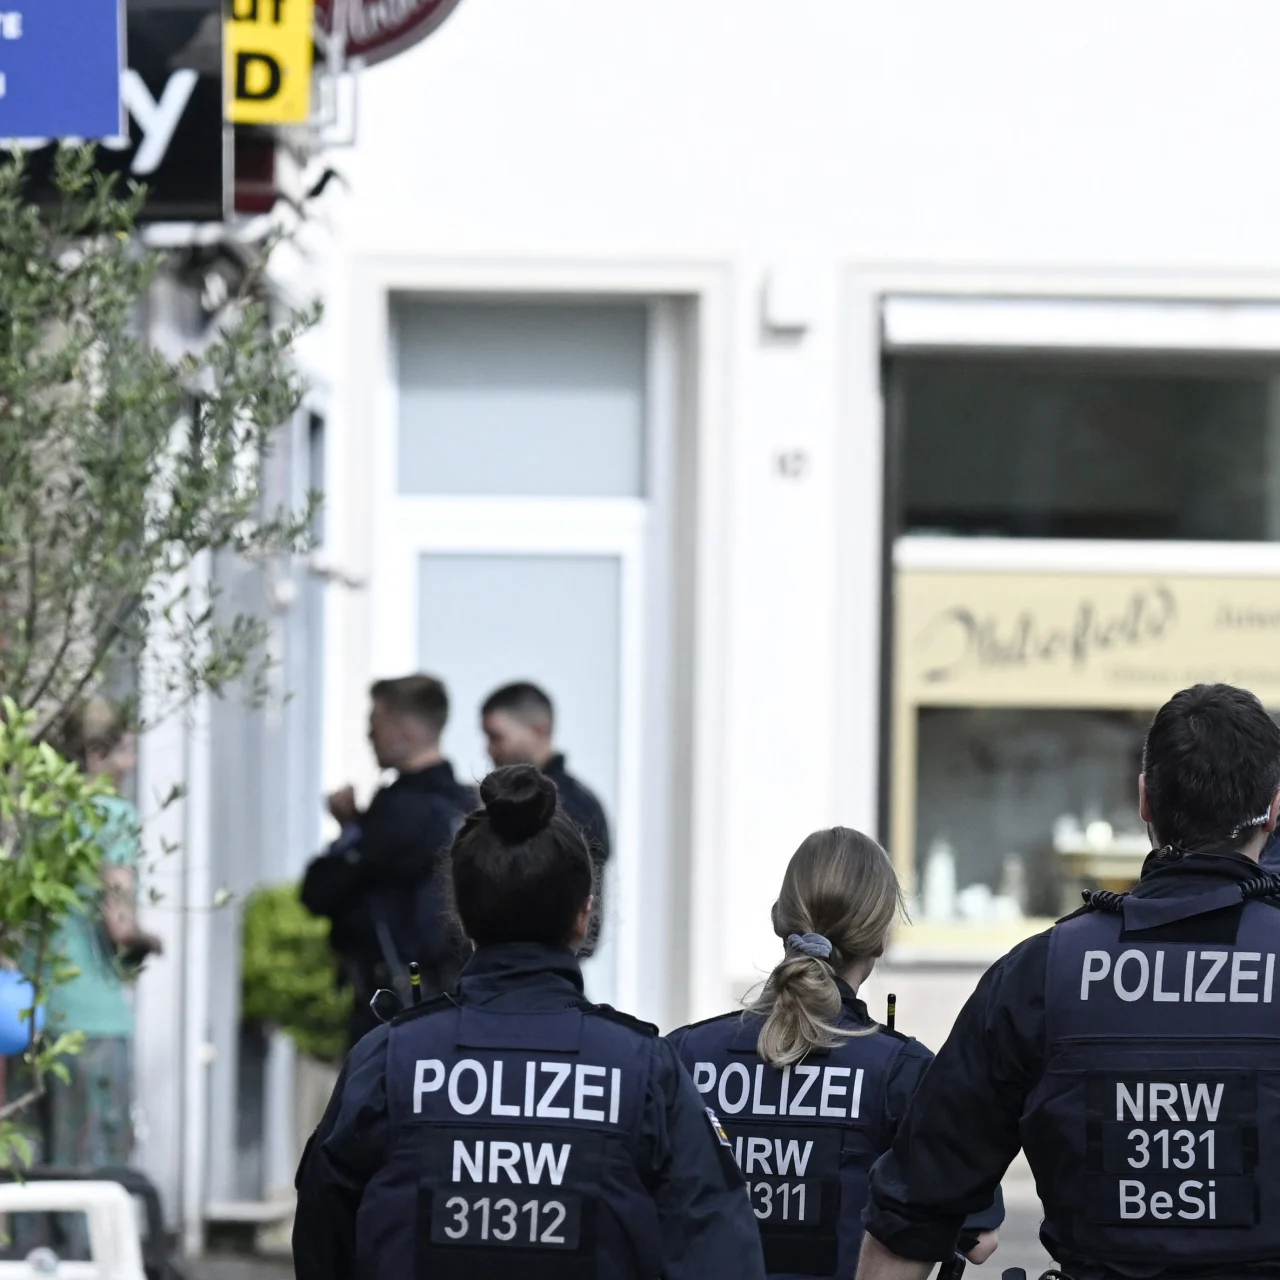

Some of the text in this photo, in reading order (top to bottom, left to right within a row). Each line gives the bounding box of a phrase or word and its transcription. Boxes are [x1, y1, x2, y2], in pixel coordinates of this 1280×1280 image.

[1080, 950, 1275, 1003] POLIZEI
[412, 1058, 621, 1124] POLIZEI
[693, 1061, 865, 1119] POLIZEI
[1116, 1082, 1224, 1122] NRW
[451, 1140, 572, 1186] NRW
[1127, 1129, 1216, 1170] 3131
[444, 1196, 566, 1244] 31312
[1119, 1179, 1217, 1220] BeSi
